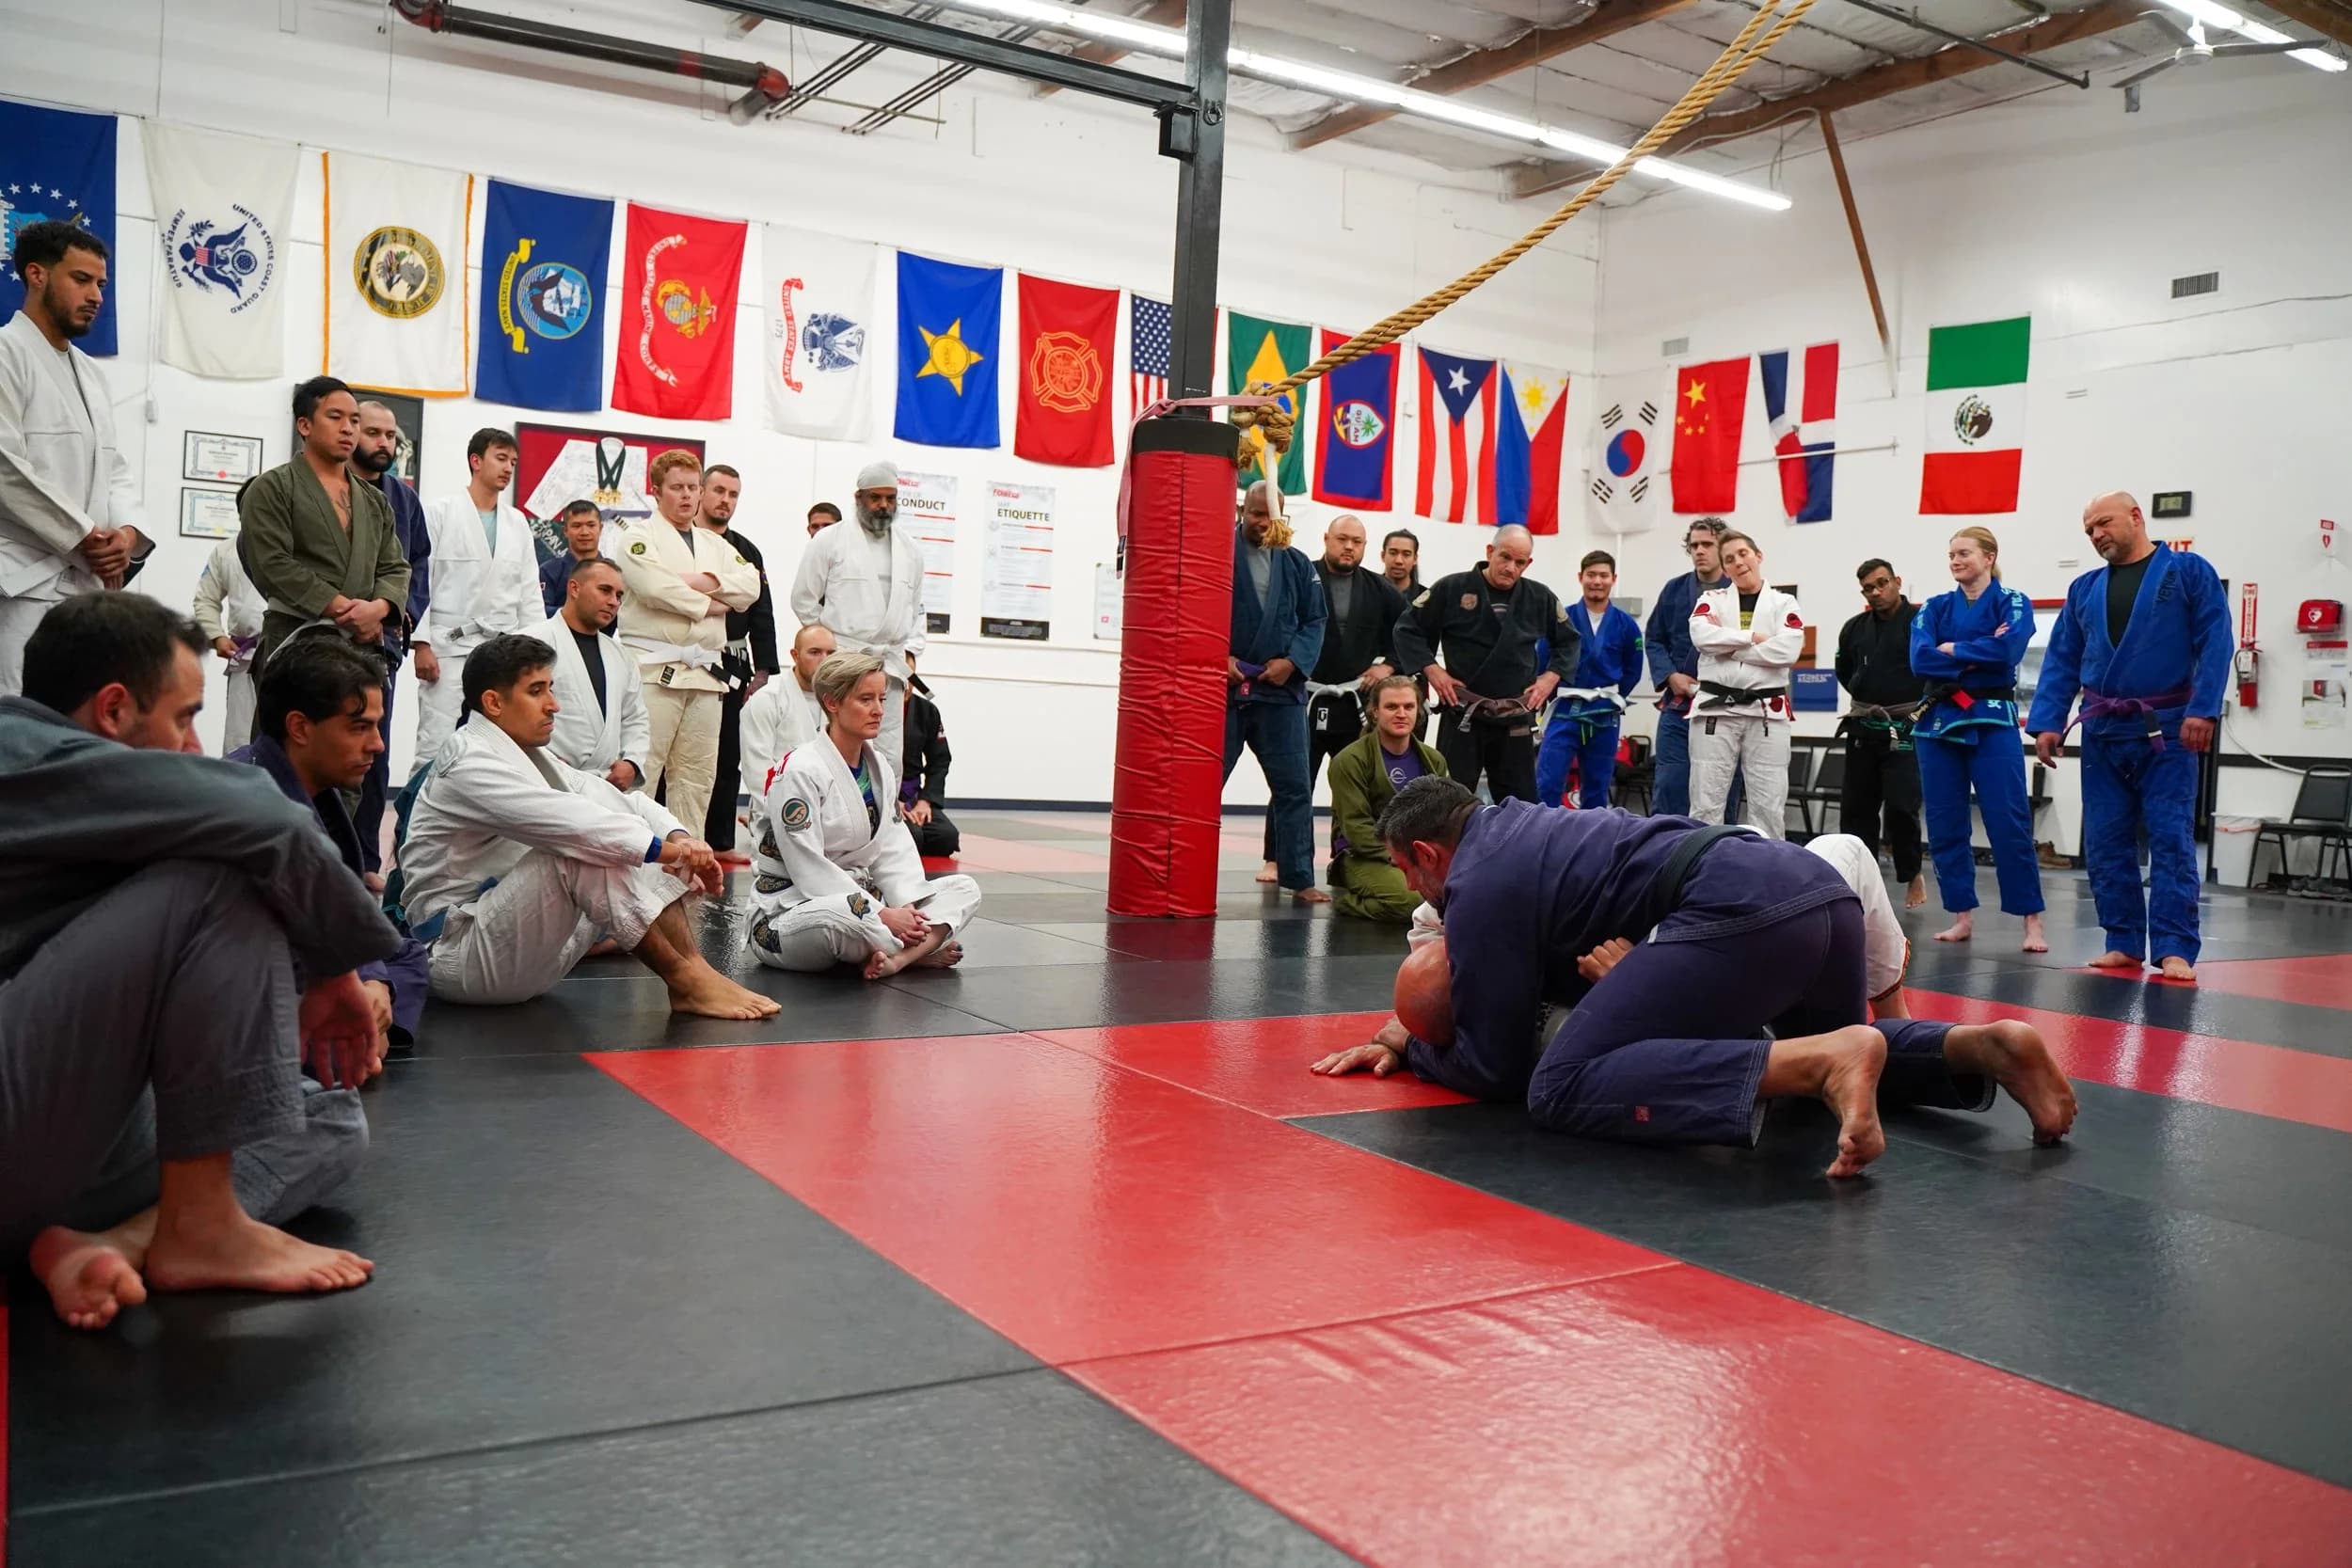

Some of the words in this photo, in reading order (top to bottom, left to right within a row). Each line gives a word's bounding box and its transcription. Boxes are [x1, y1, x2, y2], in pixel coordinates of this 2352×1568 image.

[166, 209, 185, 242] SEMPER
[232, 204, 262, 229] UNITED
[261, 230, 274, 260] STATES
[647, 239, 671, 264] UNITED
[165, 245, 183, 288] PARATUS
[259, 263, 274, 292] COAST
[230, 293, 259, 314] GUARD
[501, 281, 509, 308] STATES
[783, 285, 791, 316] UNITED
[501, 309, 512, 330] NAVY
[643, 305, 654, 334] MARINE
[787, 320, 796, 351] STATES
[642, 342, 659, 373] CORPS
[783, 353, 791, 379] ARMY
[997, 508, 1051, 521] ETIQUETTE
